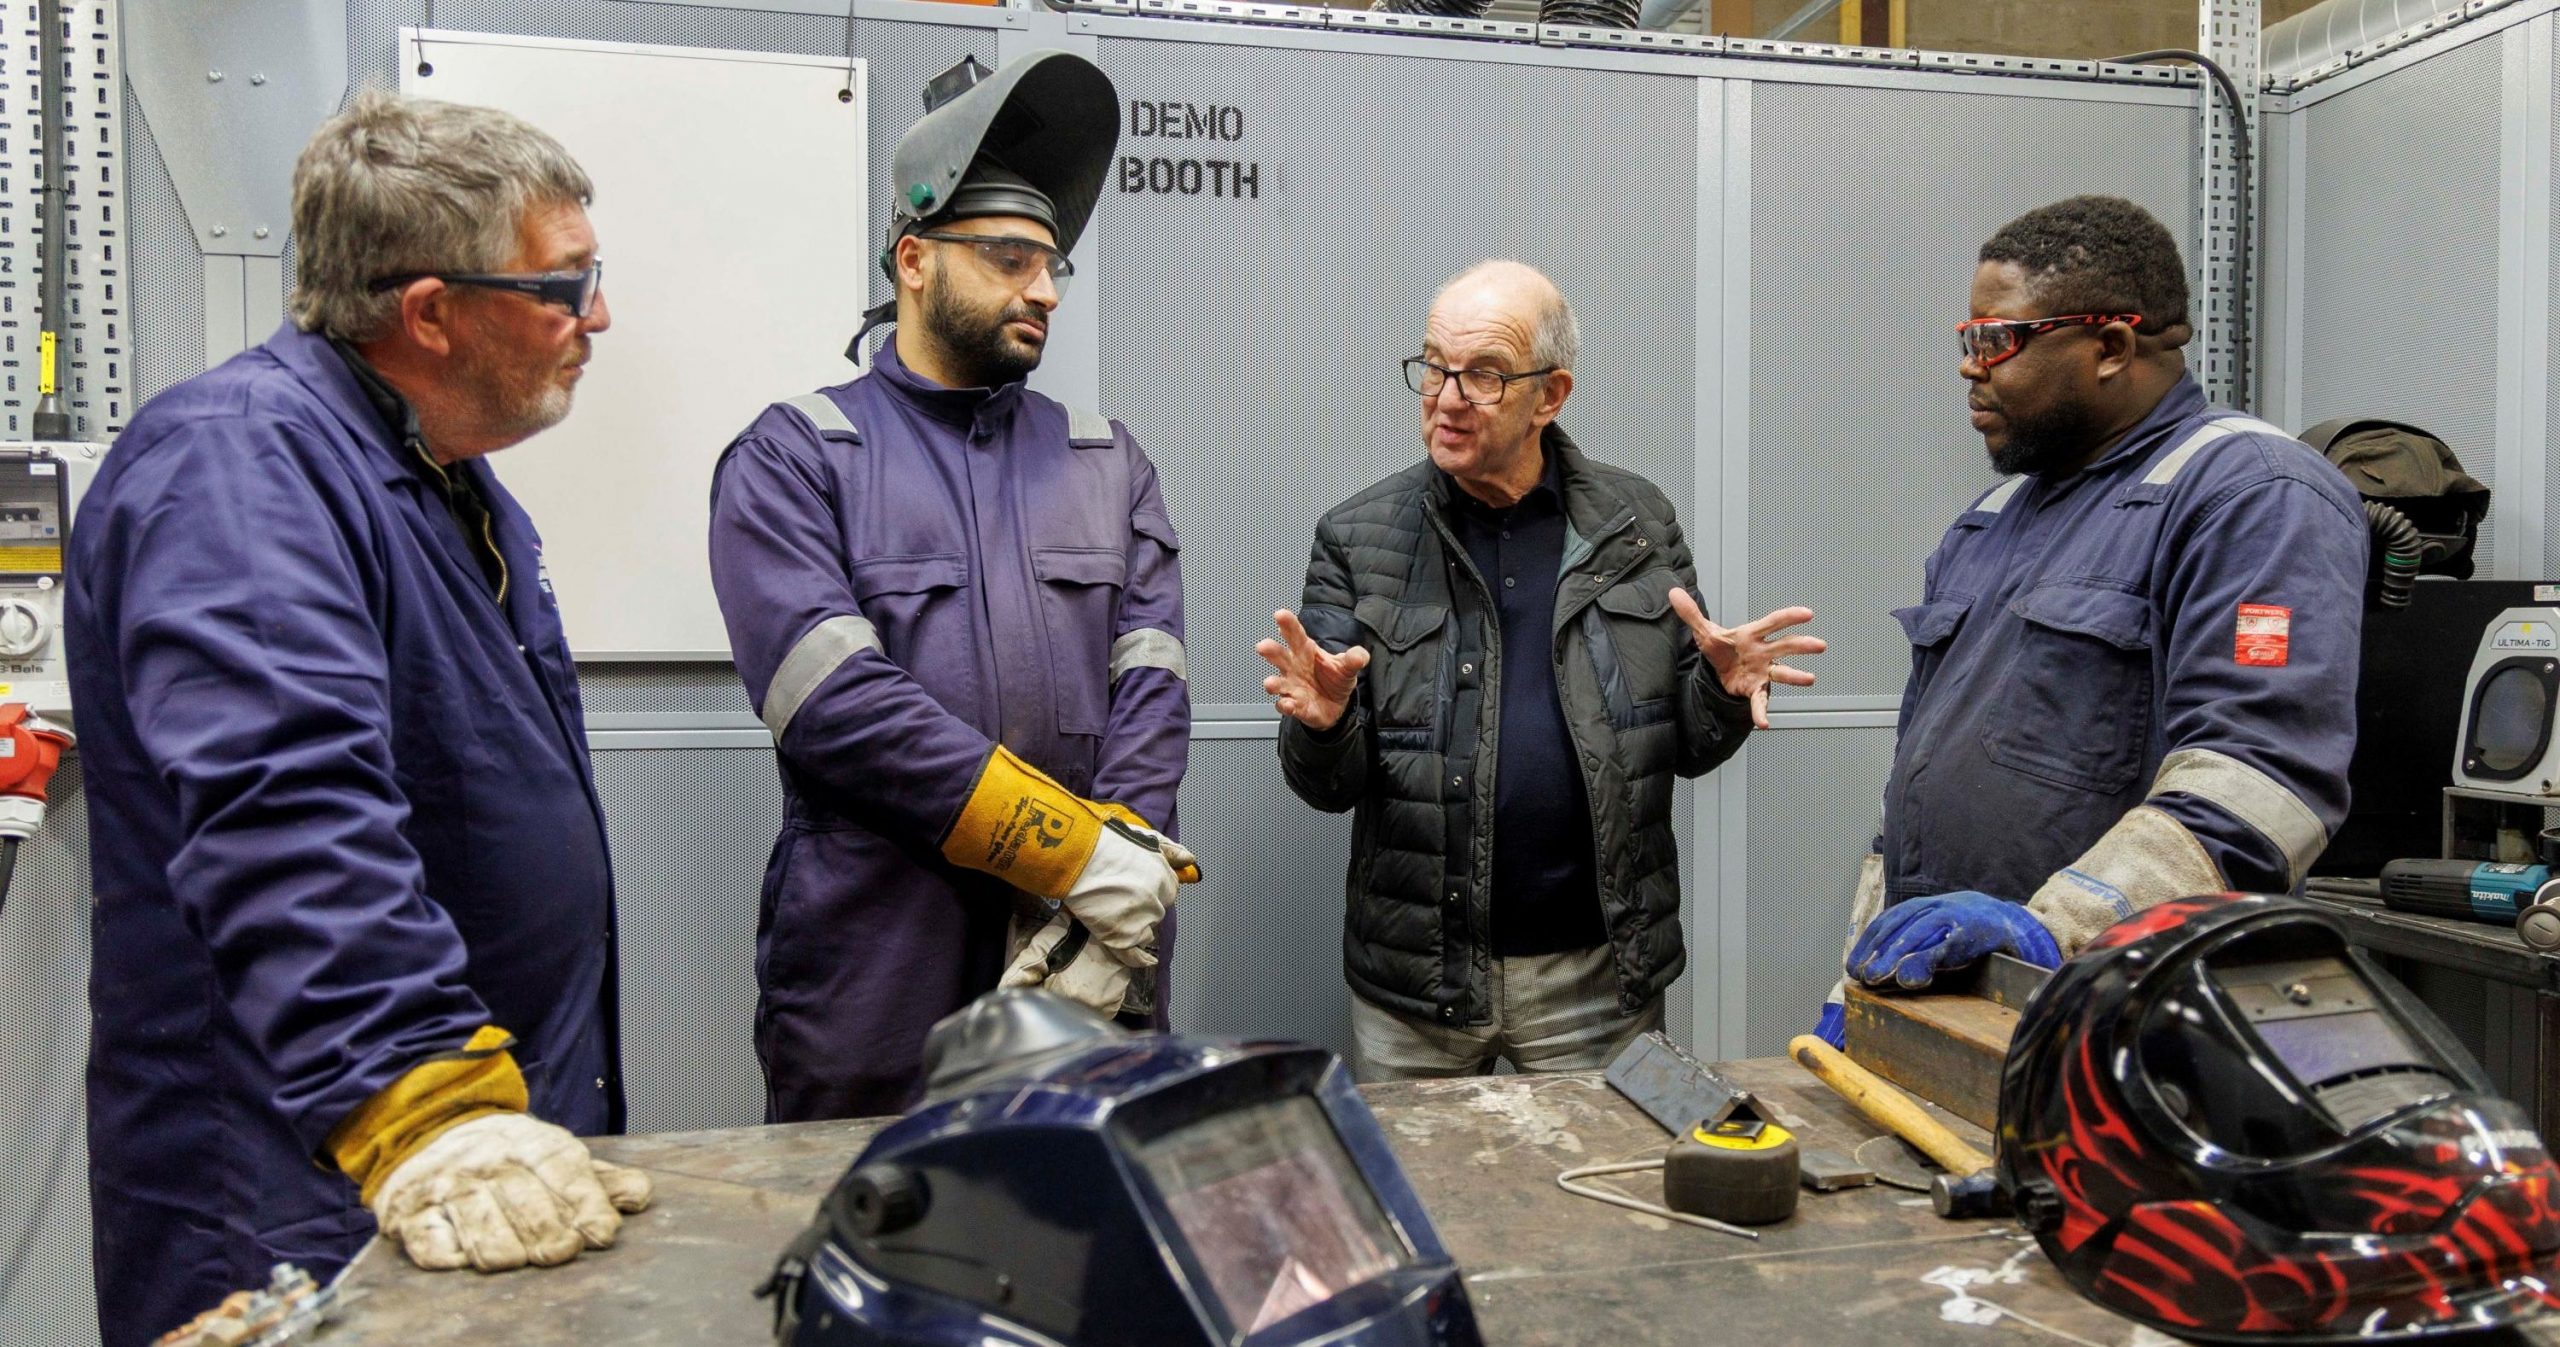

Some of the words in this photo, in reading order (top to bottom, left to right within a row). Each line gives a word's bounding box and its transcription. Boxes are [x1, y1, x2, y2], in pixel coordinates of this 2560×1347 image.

[1131, 100, 1243, 141] DEMO
[1119, 156, 1258, 199] BOOTH
[2497, 639, 2530, 647] ULTIMA
[2536, 639, 2551, 647] TIG
[11, 664, 44, 673] Bals
